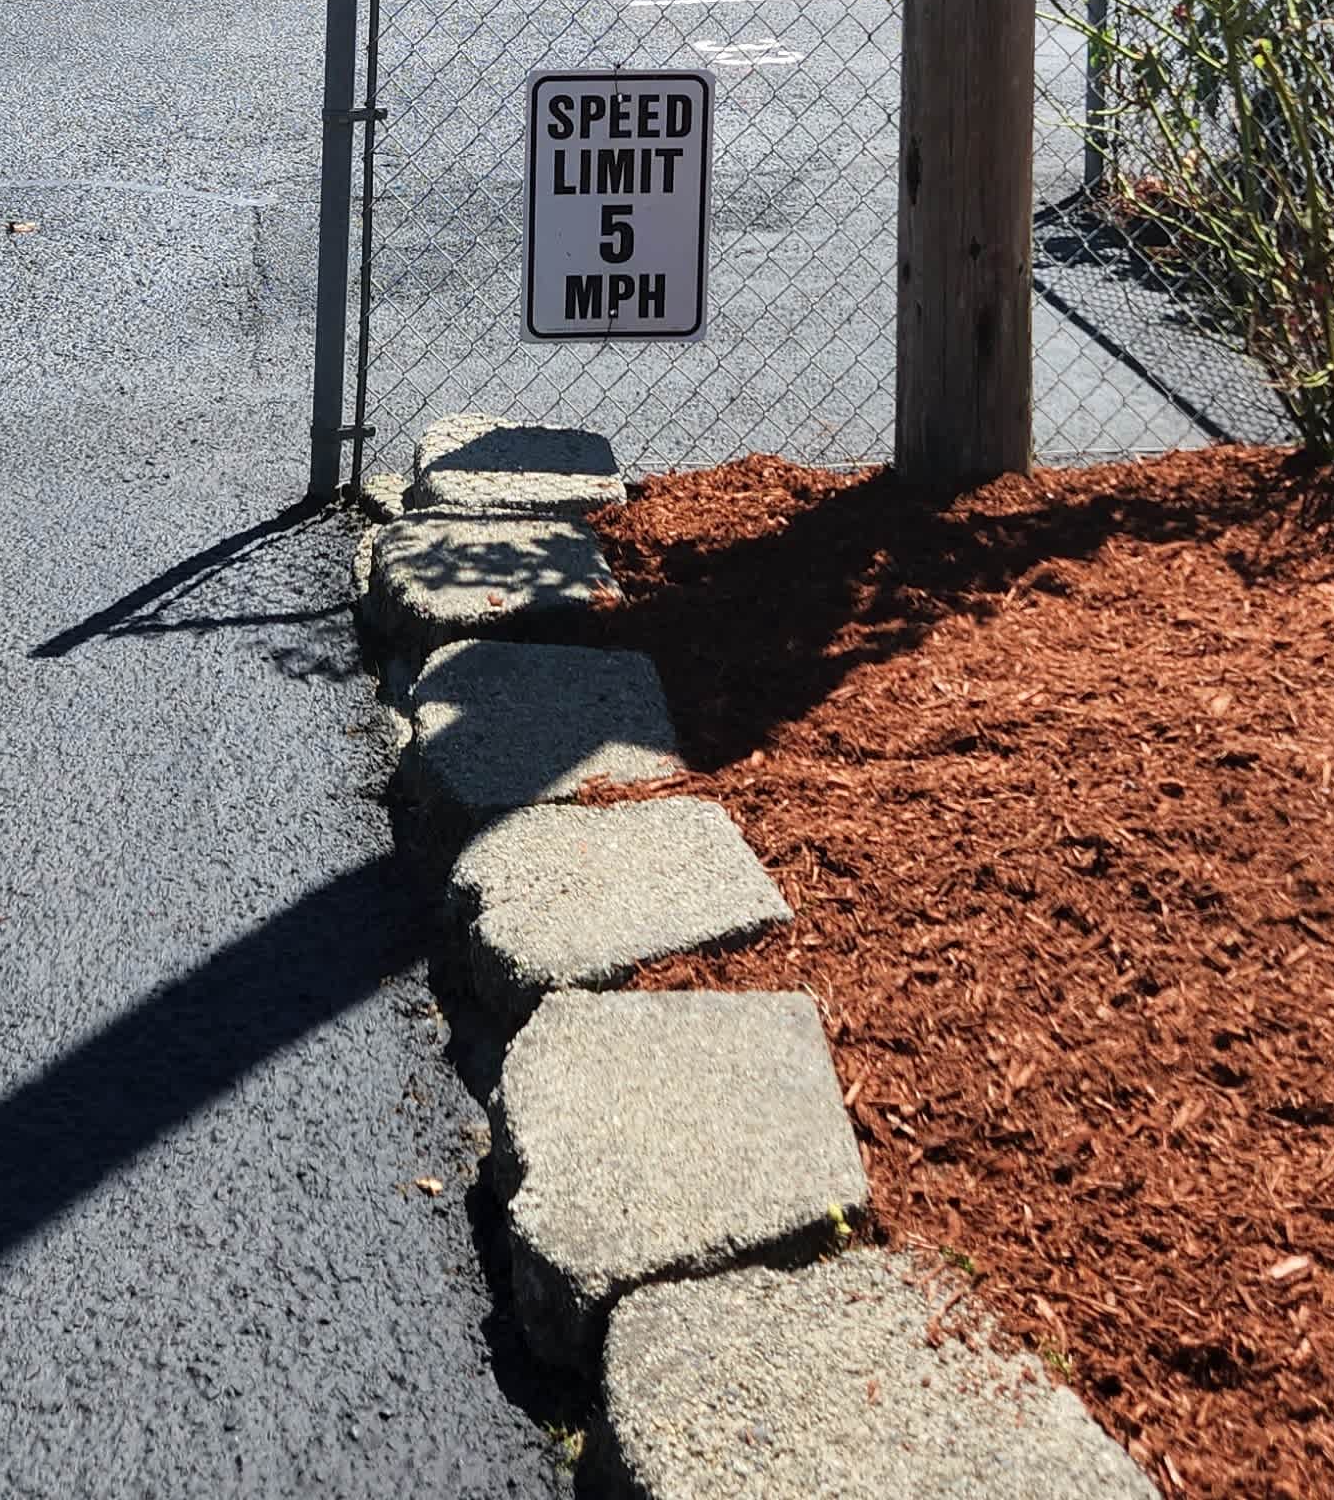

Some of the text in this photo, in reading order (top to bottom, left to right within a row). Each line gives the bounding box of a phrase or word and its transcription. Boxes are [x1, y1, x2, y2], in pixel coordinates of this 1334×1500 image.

[547, 93, 693, 140] SPEED
[553, 148, 684, 195] LIMIT
[599, 204, 635, 264] 5
[564, 273, 666, 320] MPH
